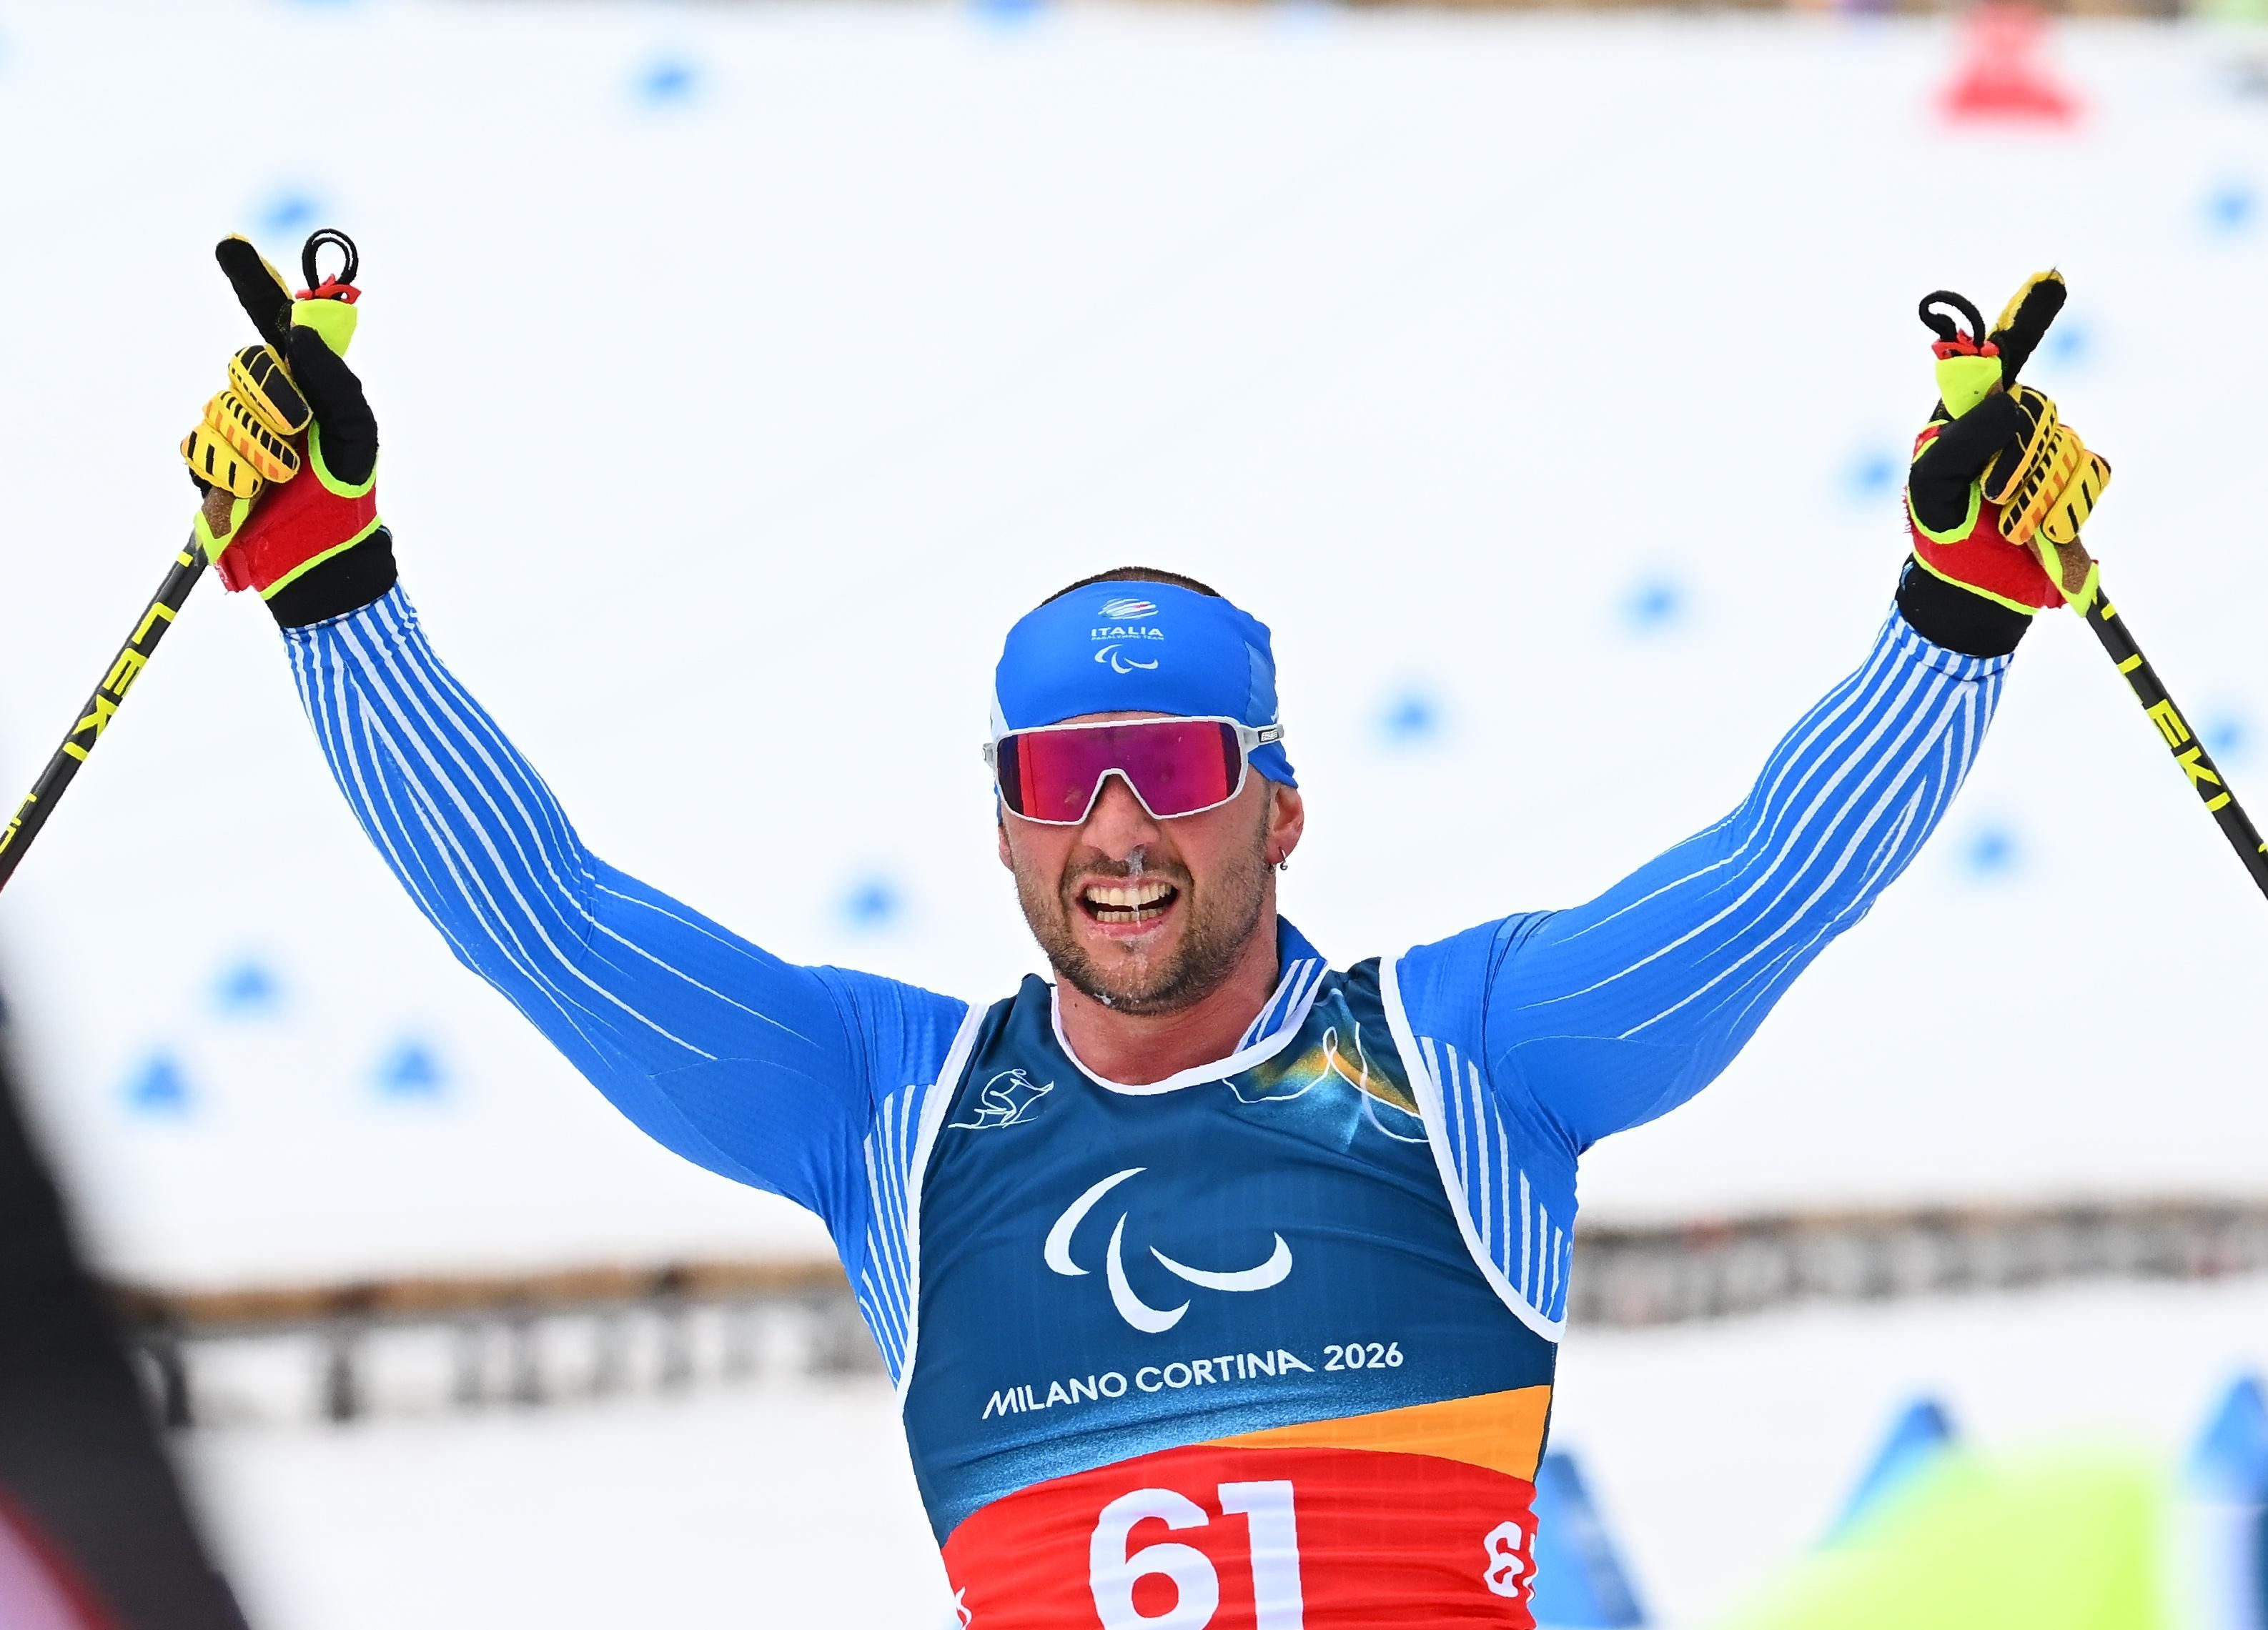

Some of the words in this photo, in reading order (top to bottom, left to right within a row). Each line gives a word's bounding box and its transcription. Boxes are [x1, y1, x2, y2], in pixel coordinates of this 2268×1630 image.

[62, 601, 177, 762] LEKI
[1091, 626, 1164, 637] ITALIA
[981, 1371, 1128, 1420] MILANO
[1135, 1348, 1315, 1393] CORTINA
[1323, 1341, 1404, 1371] 2026
[1088, 1479, 1304, 1630] 61
